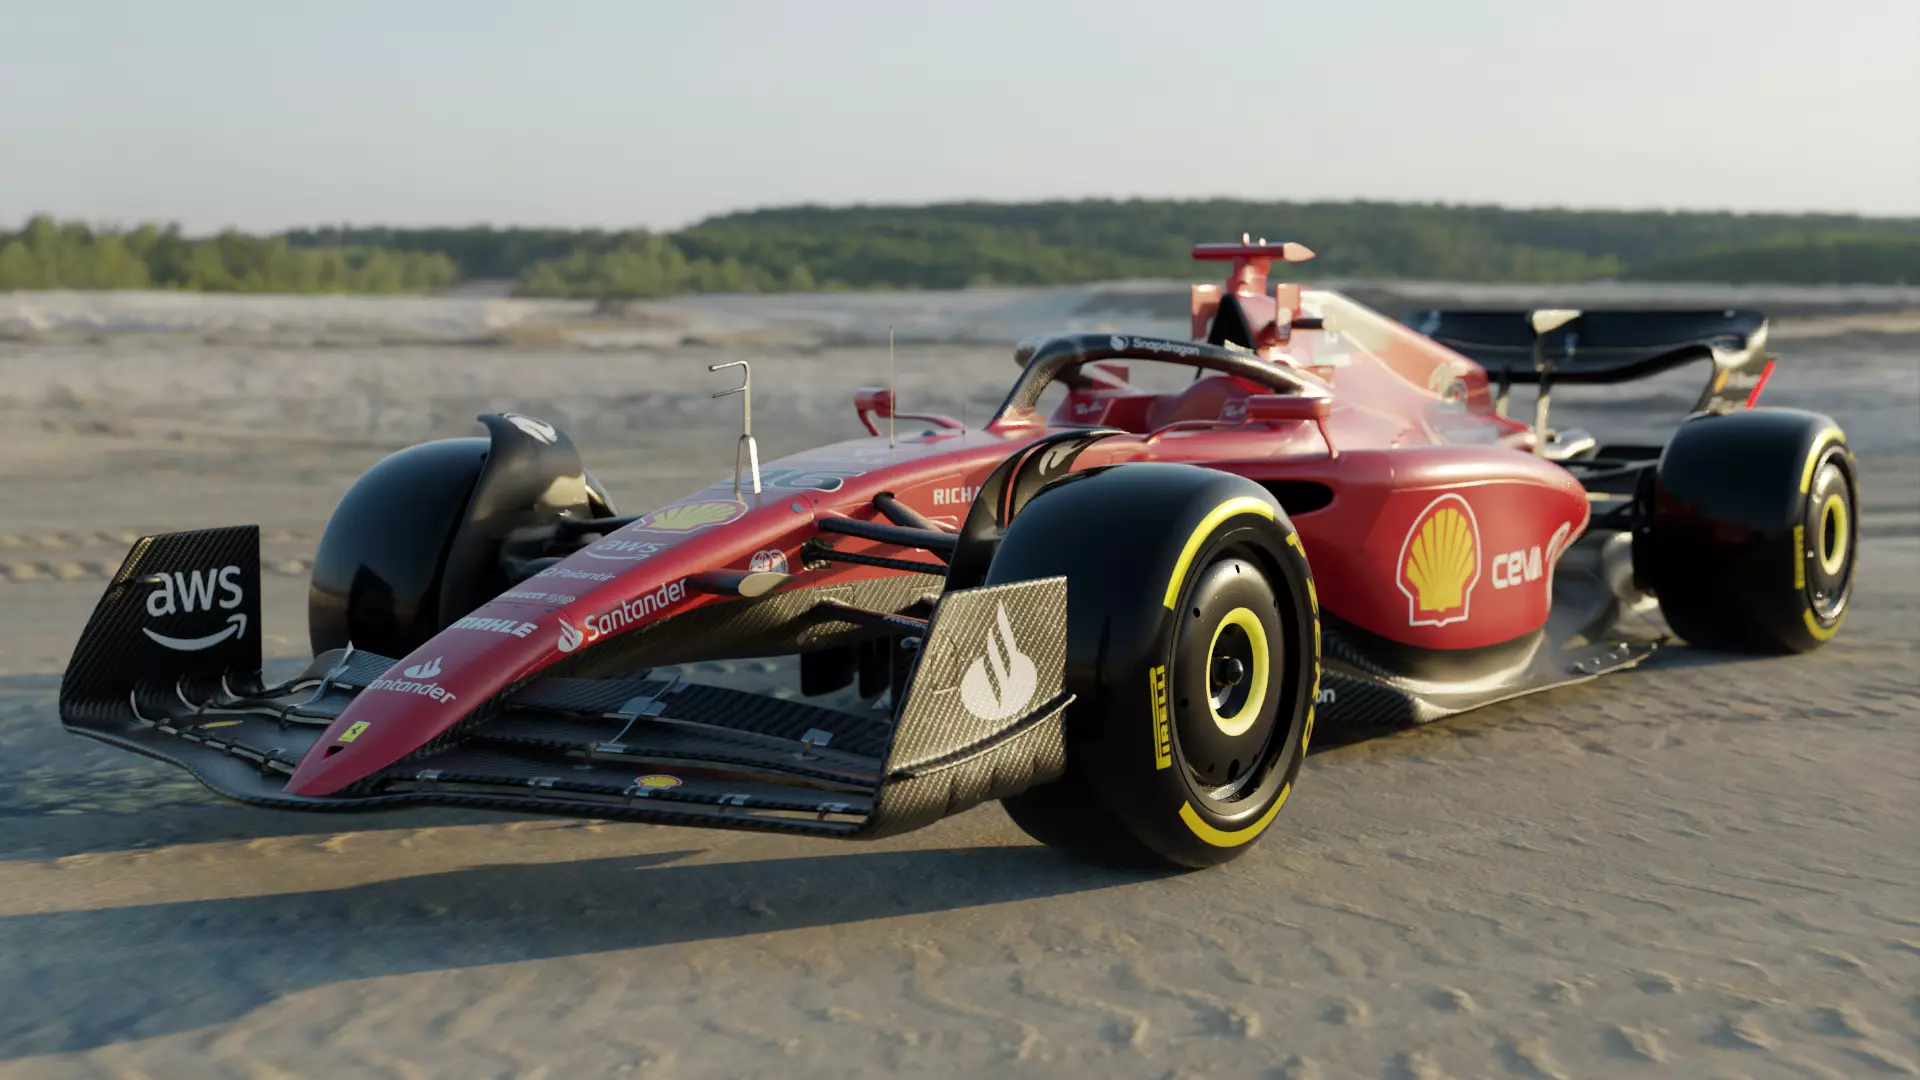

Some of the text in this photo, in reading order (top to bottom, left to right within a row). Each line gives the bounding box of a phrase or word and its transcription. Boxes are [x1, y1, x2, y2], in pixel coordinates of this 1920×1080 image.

[146, 565, 243, 617] aws
[584, 579, 687, 642] Santander
[367, 678, 457, 704] antander
[1149, 664, 1172, 770] PIRELLI
